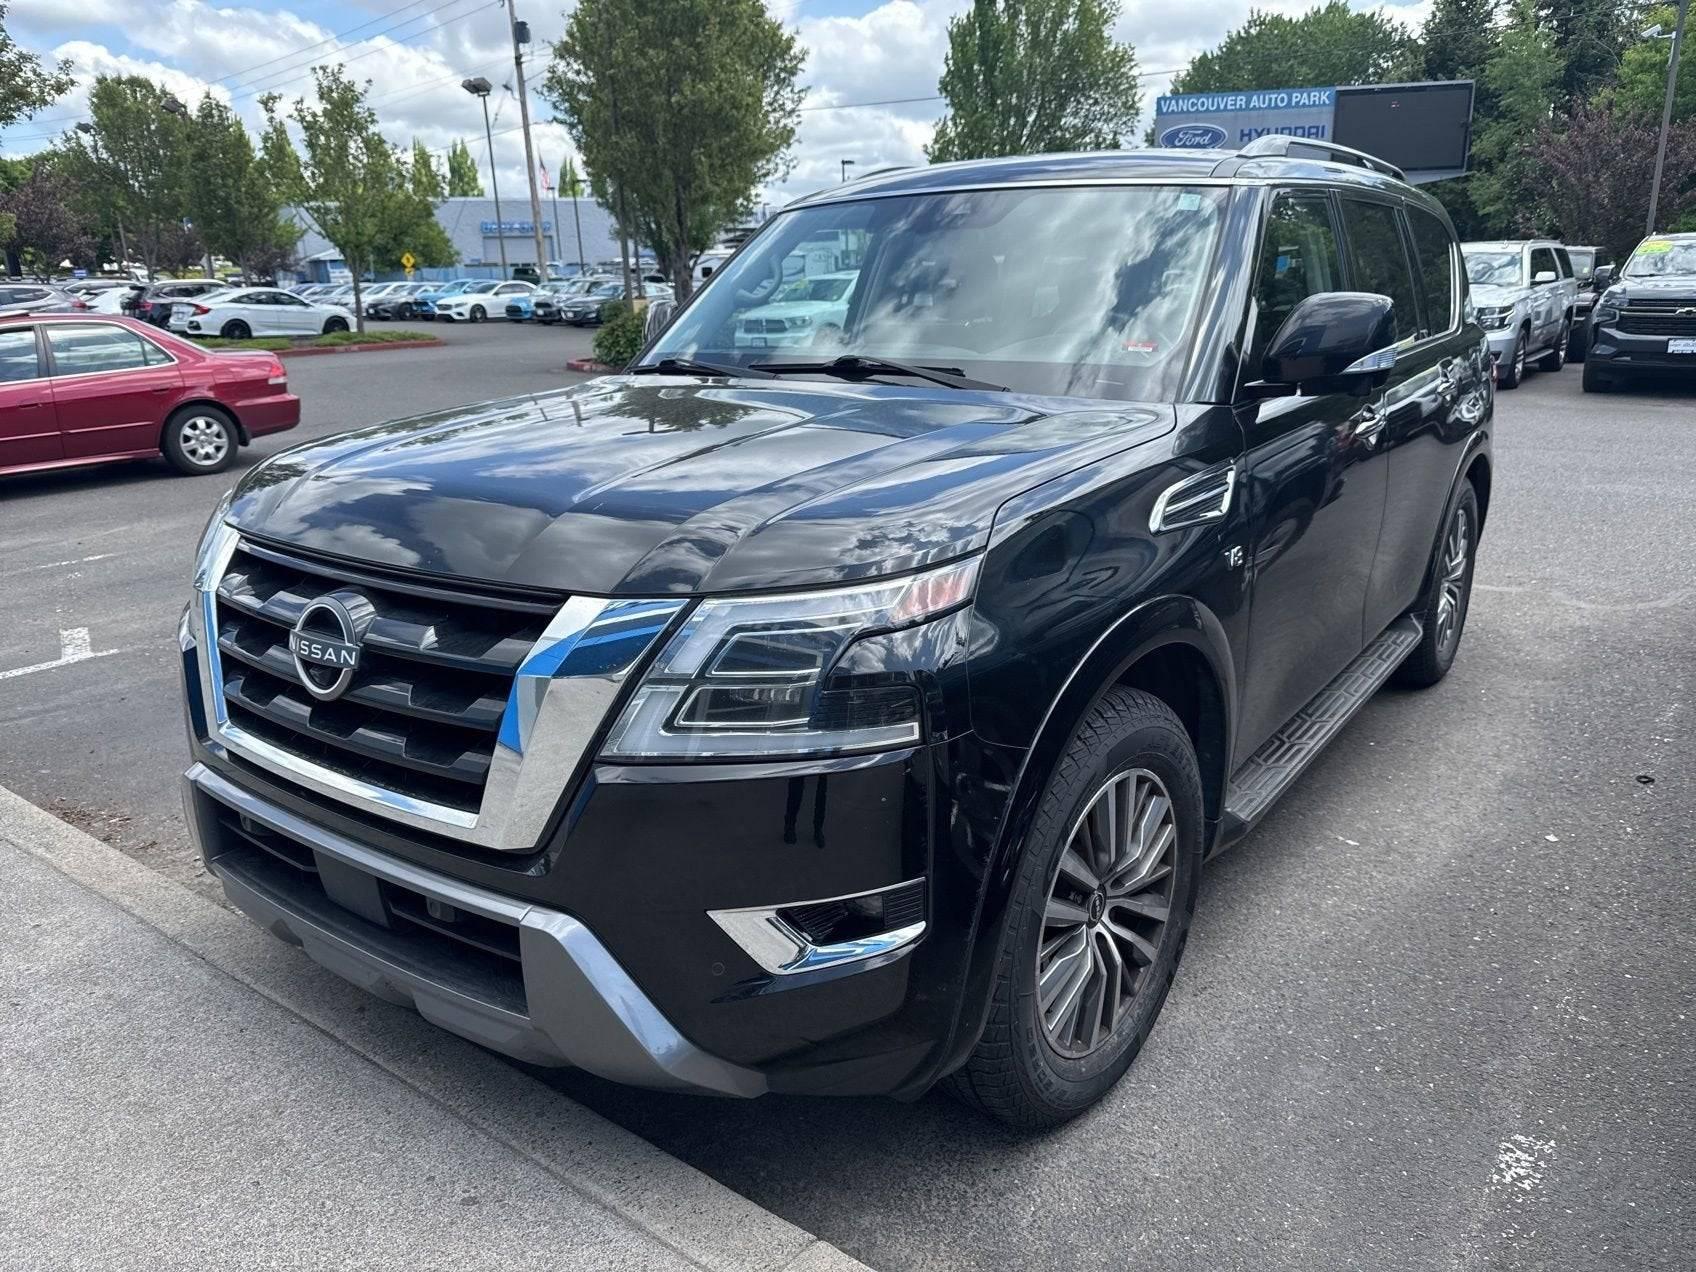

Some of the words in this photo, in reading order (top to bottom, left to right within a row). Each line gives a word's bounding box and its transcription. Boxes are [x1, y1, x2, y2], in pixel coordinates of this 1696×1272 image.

[1161, 95, 1246, 113] VANCOUVER
[1249, 92, 1288, 109] AUTO
[1292, 90, 1330, 105] PARK
[1174, 129, 1212, 146] Ford
[290, 634, 356, 665] NISSAN
